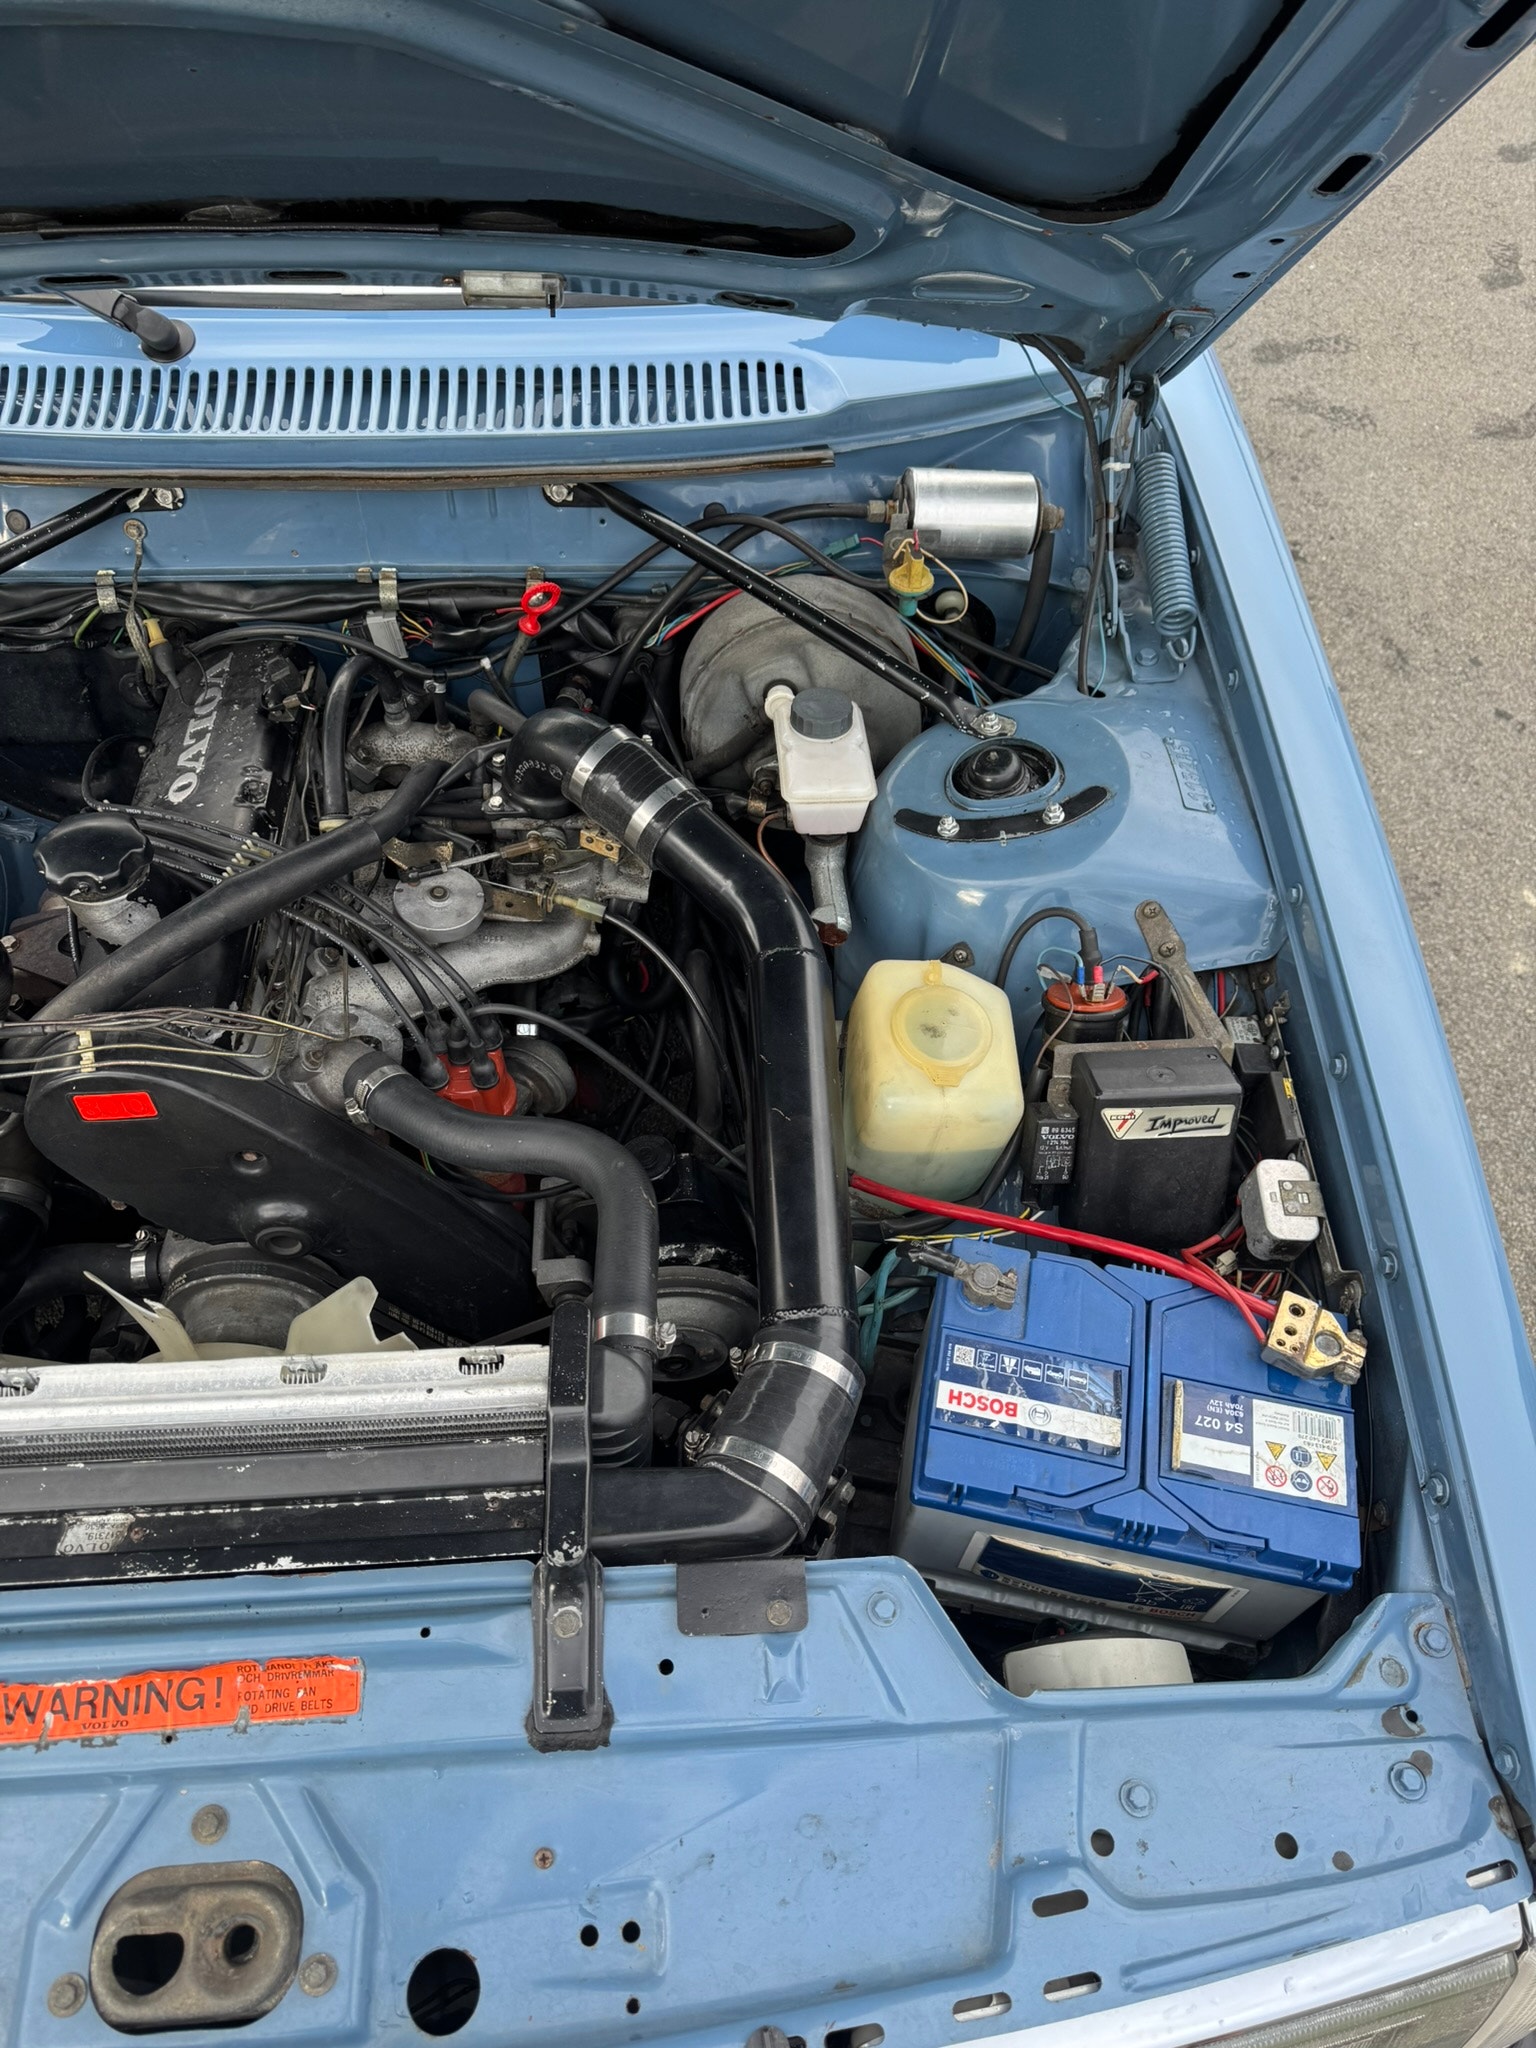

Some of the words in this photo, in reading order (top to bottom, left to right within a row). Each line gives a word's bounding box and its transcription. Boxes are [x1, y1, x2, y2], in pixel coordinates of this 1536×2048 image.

[168, 652, 233, 804] VOLVO
[1145, 1108, 1221, 1134] Improved
[948, 1388, 1018, 1418] BOSCH
[1207, 1404, 1223, 1414] (EN)
[1209, 1399, 1223, 1407] 12V
[1225, 1402, 1244, 1410] 70Ah
[1226, 1408, 1244, 1418] 630A
[1195, 1415, 1221, 1430] 027
[1225, 1422, 1244, 1434] S4
[1150, 1608, 1196, 1618] BOSCH
[3, 1676, 223, 1726] WARNING!
[265, 1701, 295, 1714] DRIVE
[301, 1698, 334, 1711] BELTS
